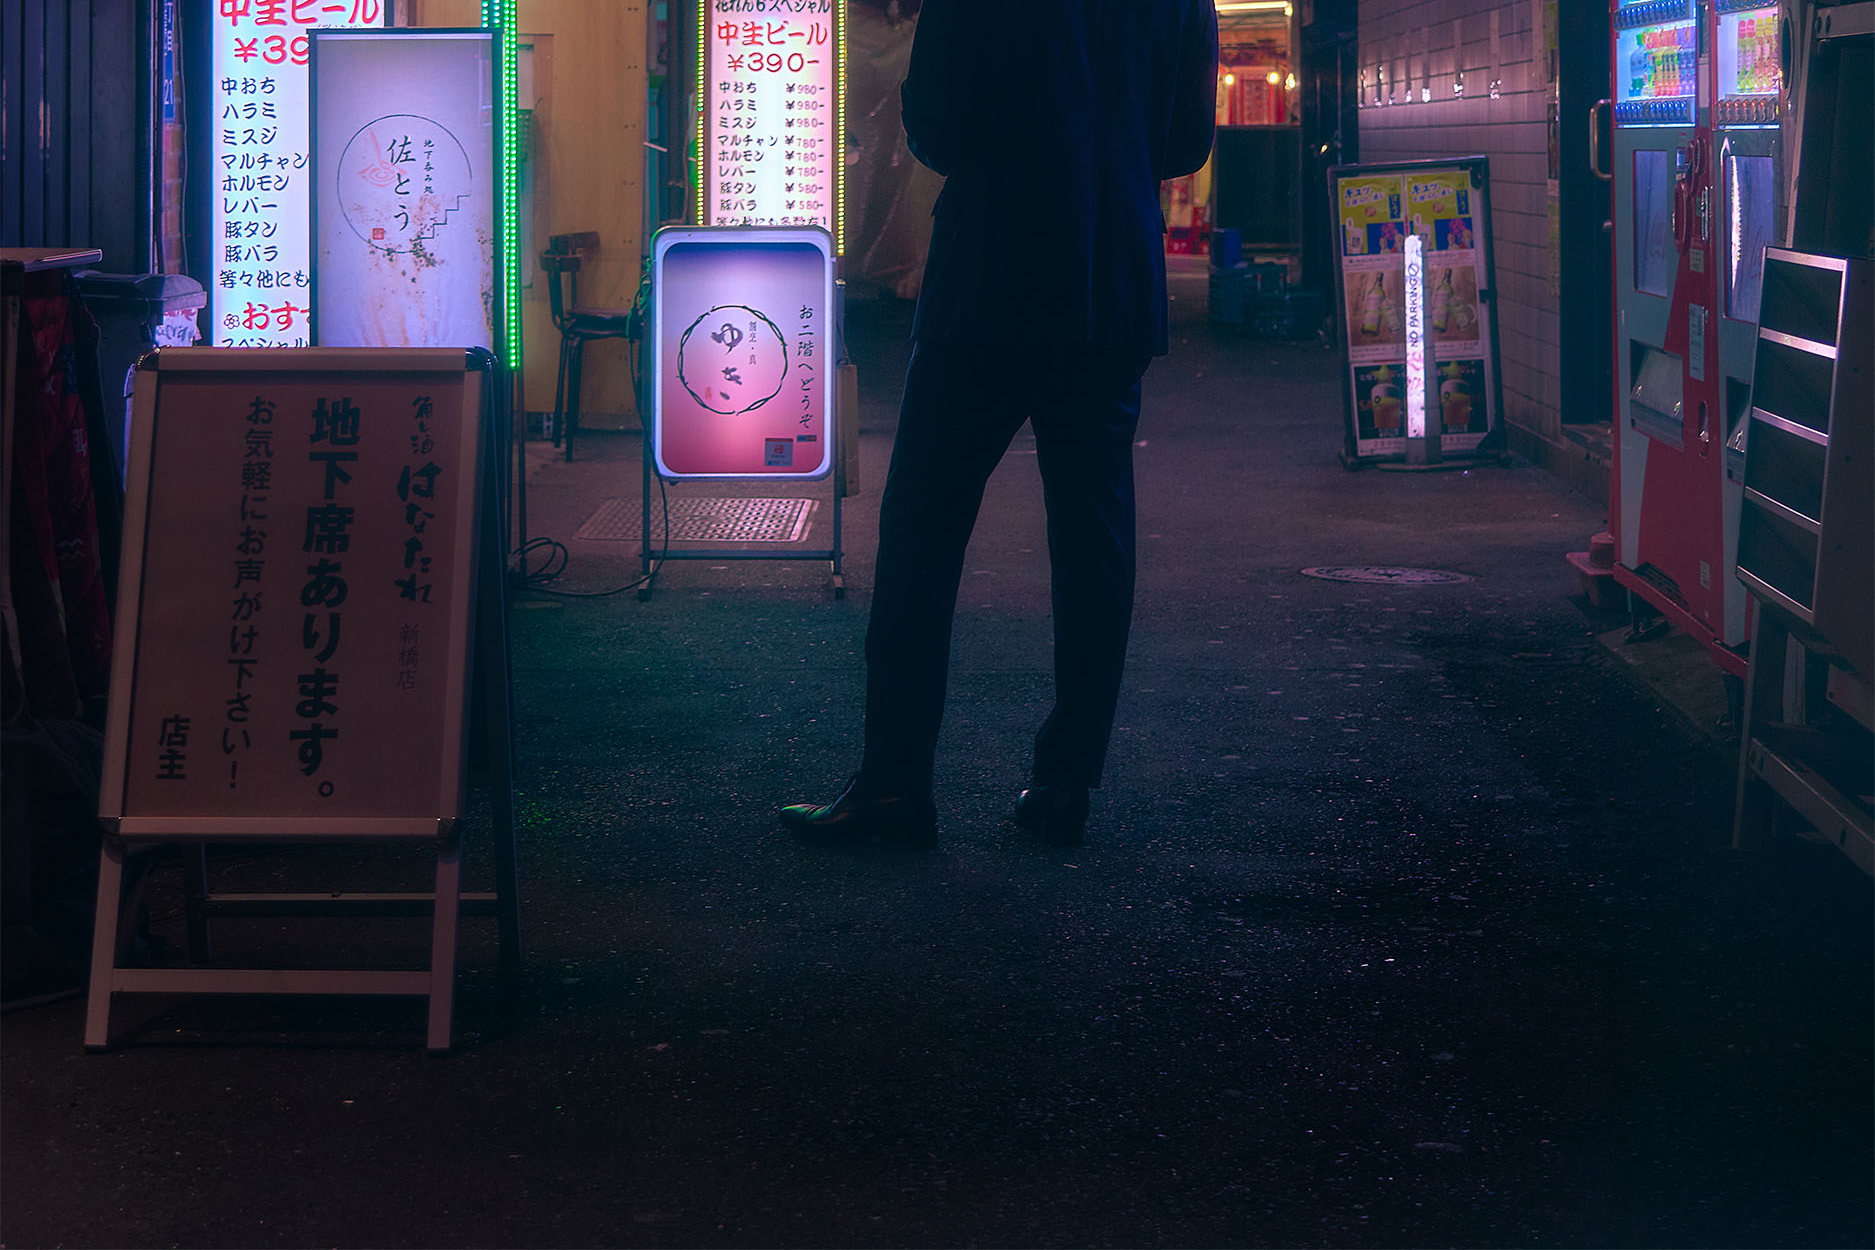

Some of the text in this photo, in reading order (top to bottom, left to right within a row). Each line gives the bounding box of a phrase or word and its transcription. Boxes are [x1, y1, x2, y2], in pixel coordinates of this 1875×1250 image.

[717, 21, 828, 46] 中生ビール
[220, 77, 277, 96] 中おち
[719, 81, 757, 94] 中おち
[221, 101, 278, 120] ハラミ
[720, 99, 757, 111] ハラミ
[719, 116, 757, 129] ミスジ
[222, 126, 278, 146] ミスジ
[717, 134, 779, 147] マルチャン
[220, 151, 309, 171] マルチャン
[718, 150, 765, 162] ホルモン
[719, 165, 756, 177] レバー
[220, 173, 290, 193] ホルモン
[386, 135, 416, 232] 佐とう
[720, 182, 757, 195] 豚タン
[222, 195, 278, 214] レバー
[720, 199, 758, 212] 豚バラ
[224, 220, 278, 239] 豚タン
[224, 244, 279, 263] 豚バラ
[219, 269, 309, 289] 等々他にも
[1408, 279, 1418, 325] PARKING
[1410, 332, 1418, 348] NO
[797, 304, 814, 429] お二階へどうぞ
[395, 460, 443, 606] はなたれ
[289, 397, 362, 799] 地下席あります。
[397, 622, 421, 691] 新橋店
[155, 713, 192, 781] 店主
